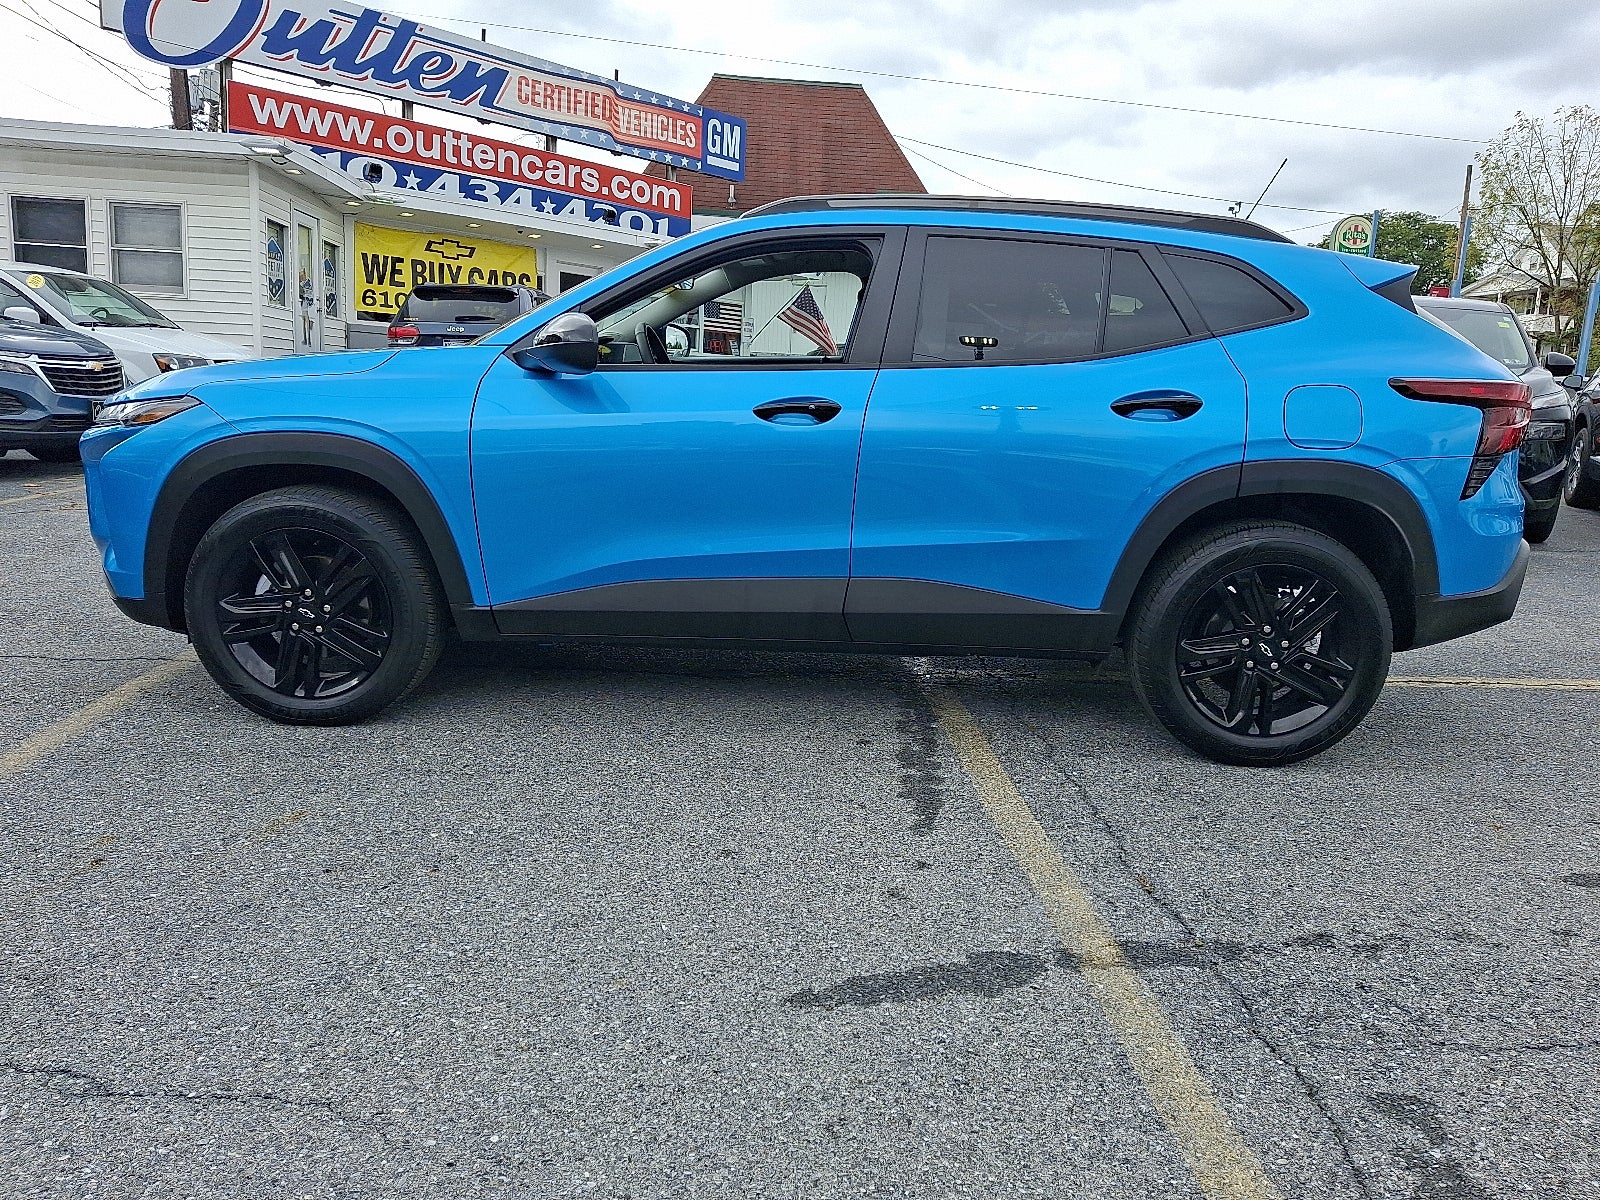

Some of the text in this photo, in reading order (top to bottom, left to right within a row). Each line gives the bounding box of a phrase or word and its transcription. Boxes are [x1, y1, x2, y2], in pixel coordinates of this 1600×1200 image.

[517, 75, 696, 149] CERTIFIED VEHICLES
[247, 93, 681, 212] www.outtencars.com
[706, 118, 741, 160] GM
[361, 252, 406, 288] WE
[411, 258, 463, 285] BUY
[446, 325, 465, 333] Jeep
